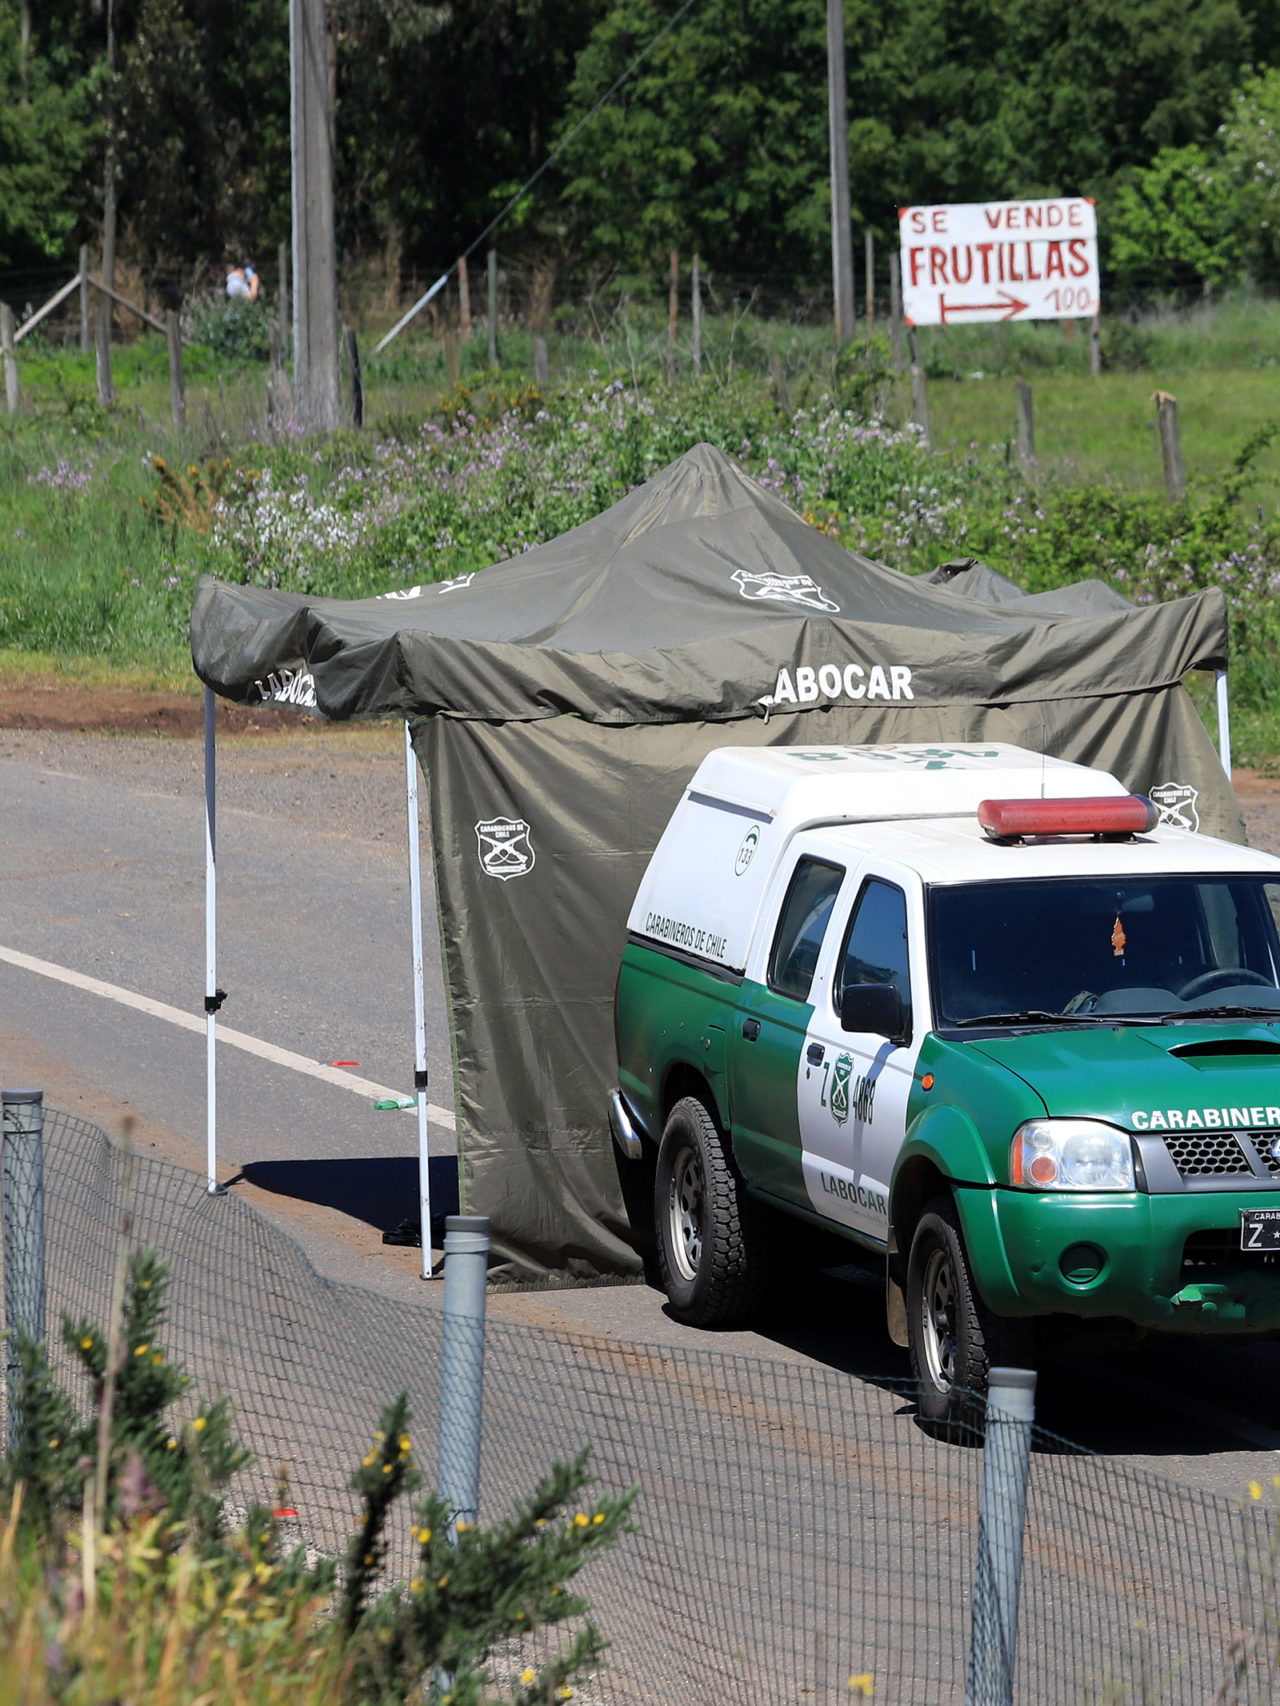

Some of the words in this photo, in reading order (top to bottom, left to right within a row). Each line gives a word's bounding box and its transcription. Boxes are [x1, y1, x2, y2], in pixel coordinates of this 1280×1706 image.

[911, 210, 947, 234] SE
[984, 203, 1083, 230] VENDE
[909, 238, 1090, 286] FRUTILLAS
[738, 847, 753, 865] 133
[645, 911, 696, 947] CARABINEROS
[694, 929, 706, 951] DE
[705, 933, 727, 958] CHILE
[821, 1061, 830, 1107] Z
[853, 1075, 877, 1125] 4868
[821, 1172, 887, 1215] LABOCAR
[1247, 1223, 1263, 1248] Z
